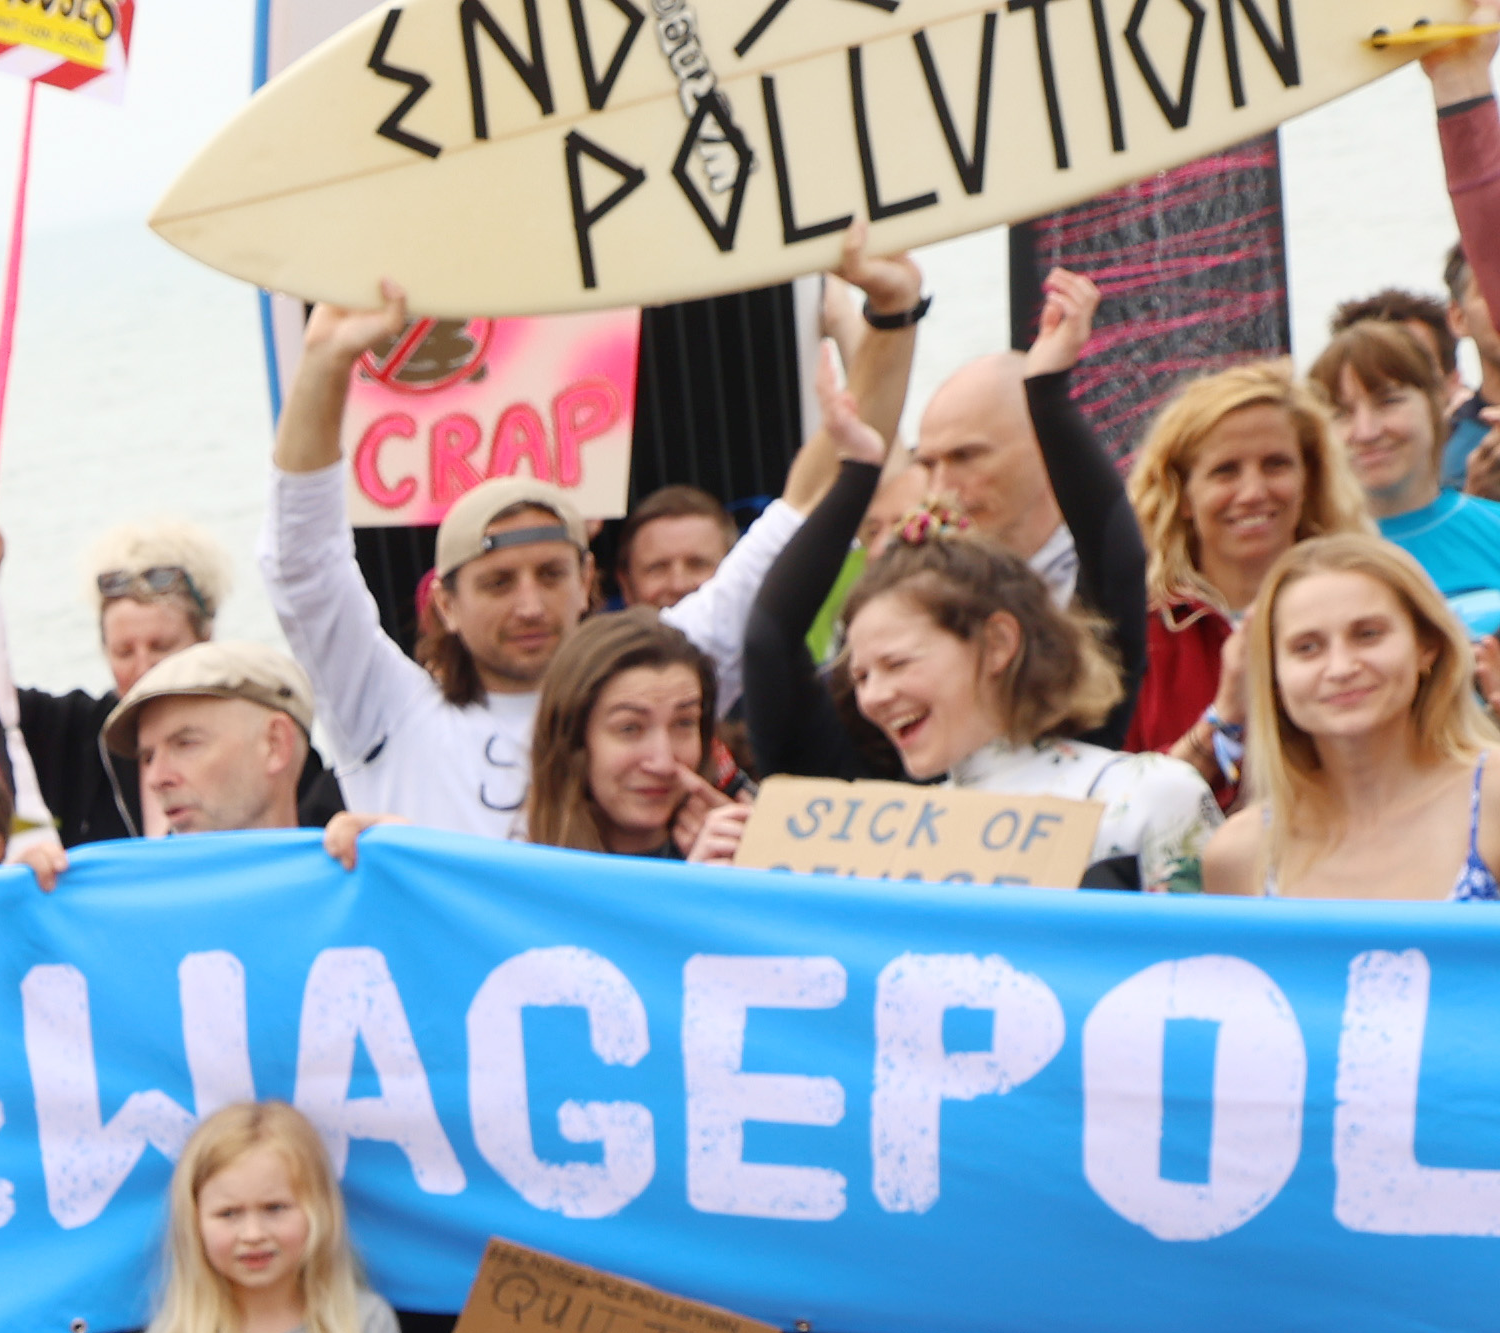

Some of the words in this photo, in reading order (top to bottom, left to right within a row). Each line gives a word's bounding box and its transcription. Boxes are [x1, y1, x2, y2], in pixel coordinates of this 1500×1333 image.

[353, 375, 622, 510] CRAP
[786, 797, 948, 848] SICK
[980, 808, 1064, 854] OF
